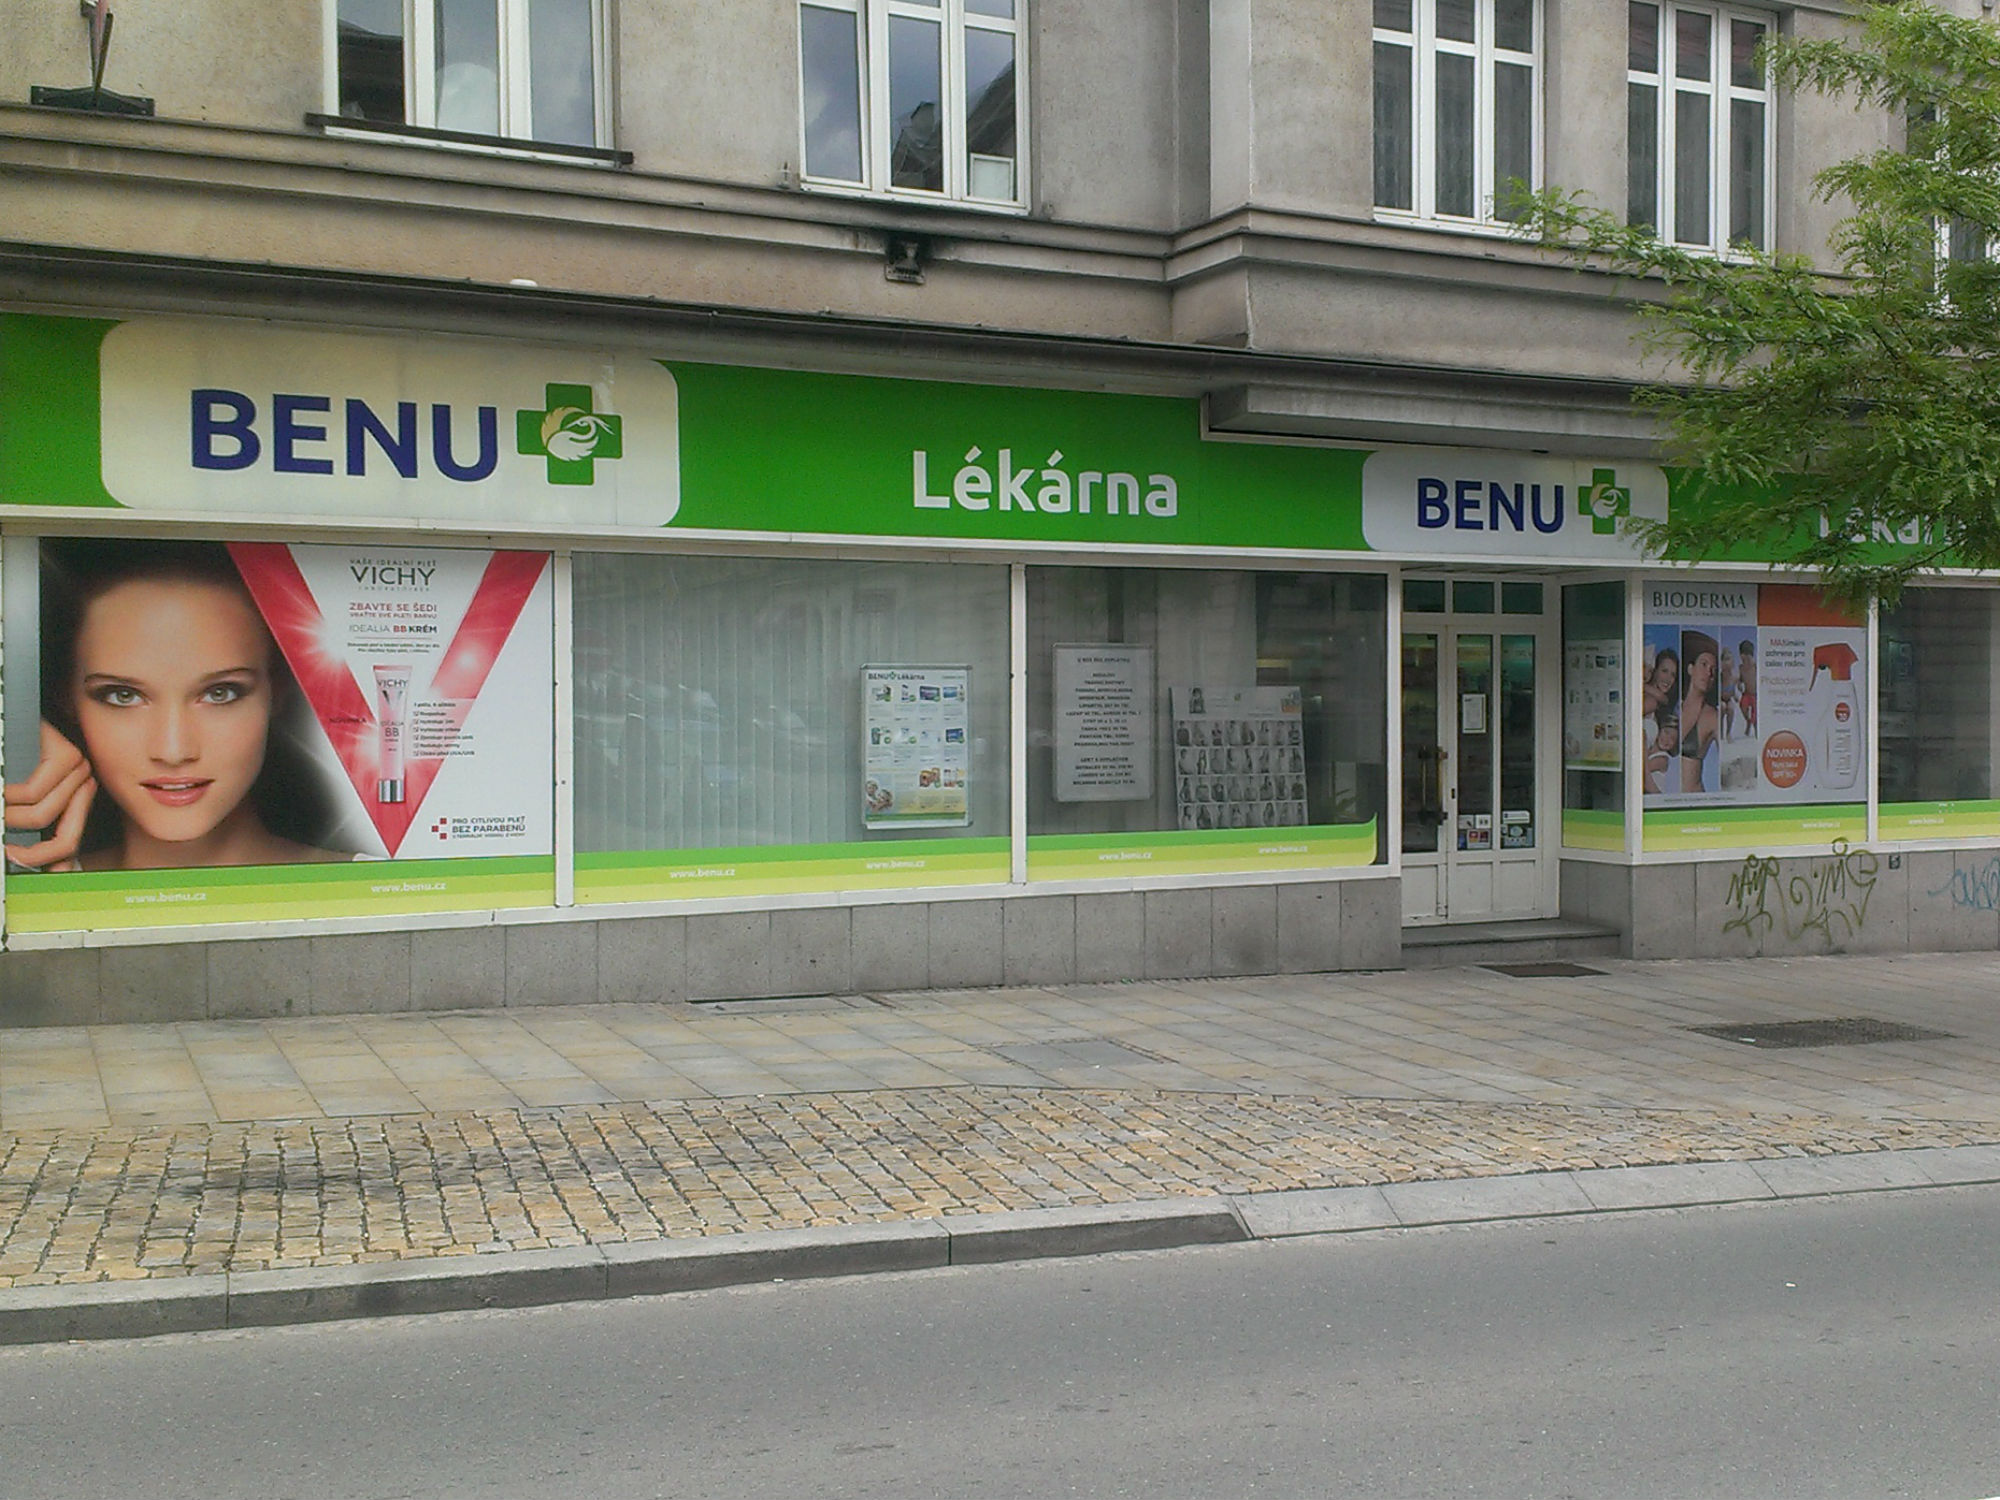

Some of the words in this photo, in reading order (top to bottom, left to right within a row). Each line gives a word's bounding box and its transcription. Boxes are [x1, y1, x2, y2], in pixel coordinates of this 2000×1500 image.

[190, 387, 499, 484] BENU
[912, 445, 1178, 517] Lékárna
[1417, 477, 1564, 534] BENU
[350, 566, 436, 586] VICHY
[1652, 592, 1747, 609] BIODERMA
[349, 602, 393, 611] ZBAVTE
[396, 603, 410, 612] SE
[413, 602, 437, 612] ŠEDI
[349, 624, 390, 633] IDEALIA
[408, 624, 437, 633] KRÉM
[376, 679, 408, 688] VICHY
[385, 727, 399, 737] BB
[1766, 748, 1804, 758] NOVINKA
[452, 825, 470, 833] BEZ
[669, 867, 736, 878] www.benu.cz
[371, 882, 447, 893] www.benu.cz
[124, 892, 207, 904] www.benu.cz
